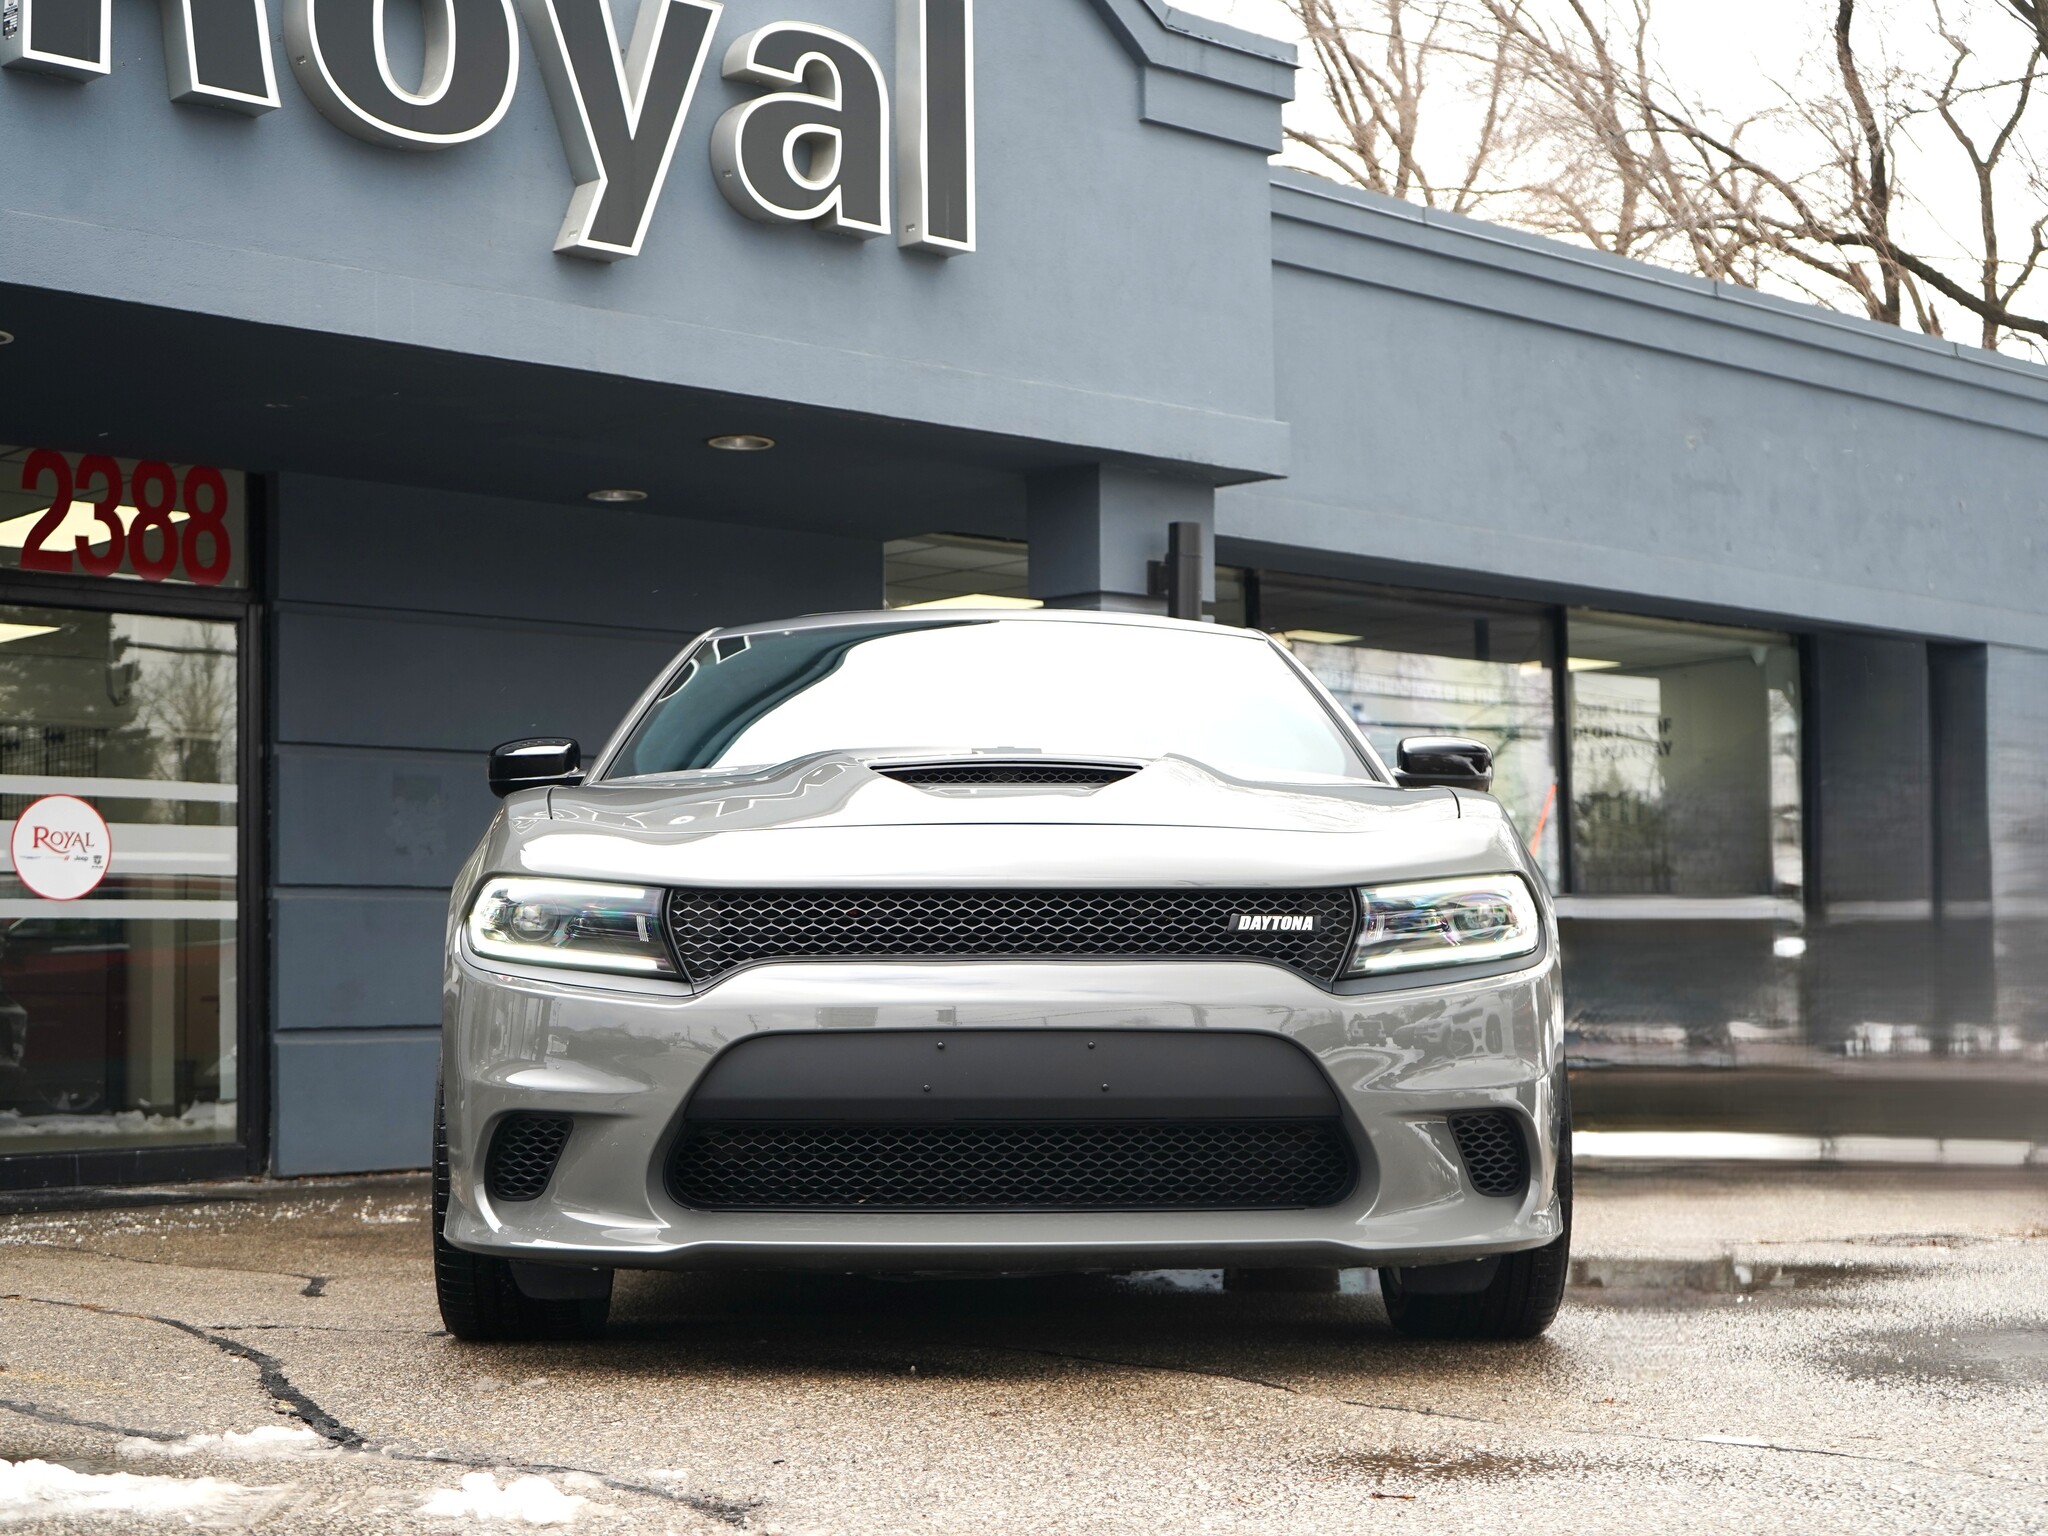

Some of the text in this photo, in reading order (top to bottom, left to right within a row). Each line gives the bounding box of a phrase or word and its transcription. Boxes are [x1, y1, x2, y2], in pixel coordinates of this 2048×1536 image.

[20, 448, 231, 586] 2388
[32, 826, 95, 854] ROYAL
[1238, 915, 1313, 930] DAYTONA
